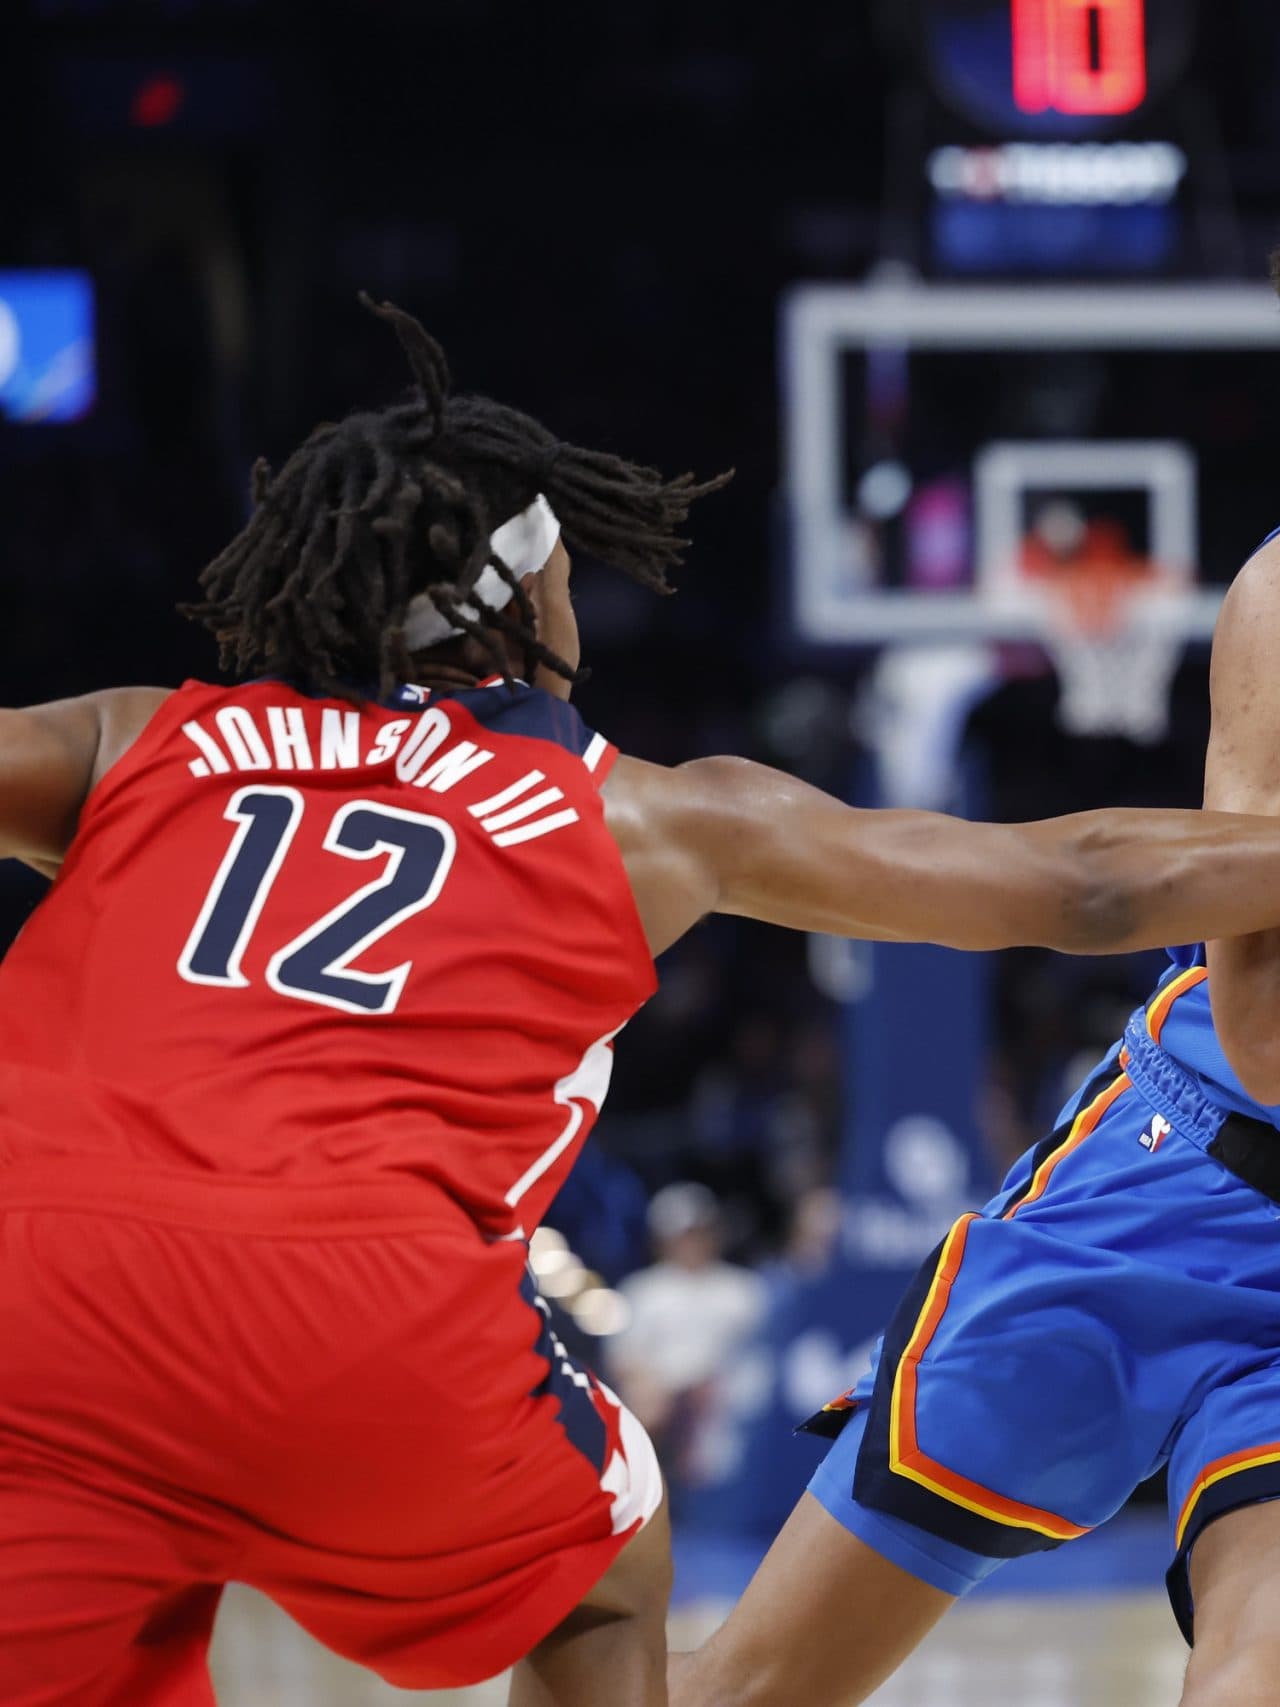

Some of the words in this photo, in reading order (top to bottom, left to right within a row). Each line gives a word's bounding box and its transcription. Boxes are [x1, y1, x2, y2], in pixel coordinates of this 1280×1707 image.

[181, 705, 496, 794] JOHNSON
[466, 768, 580, 848] III
[176, 783, 457, 1015] 12
